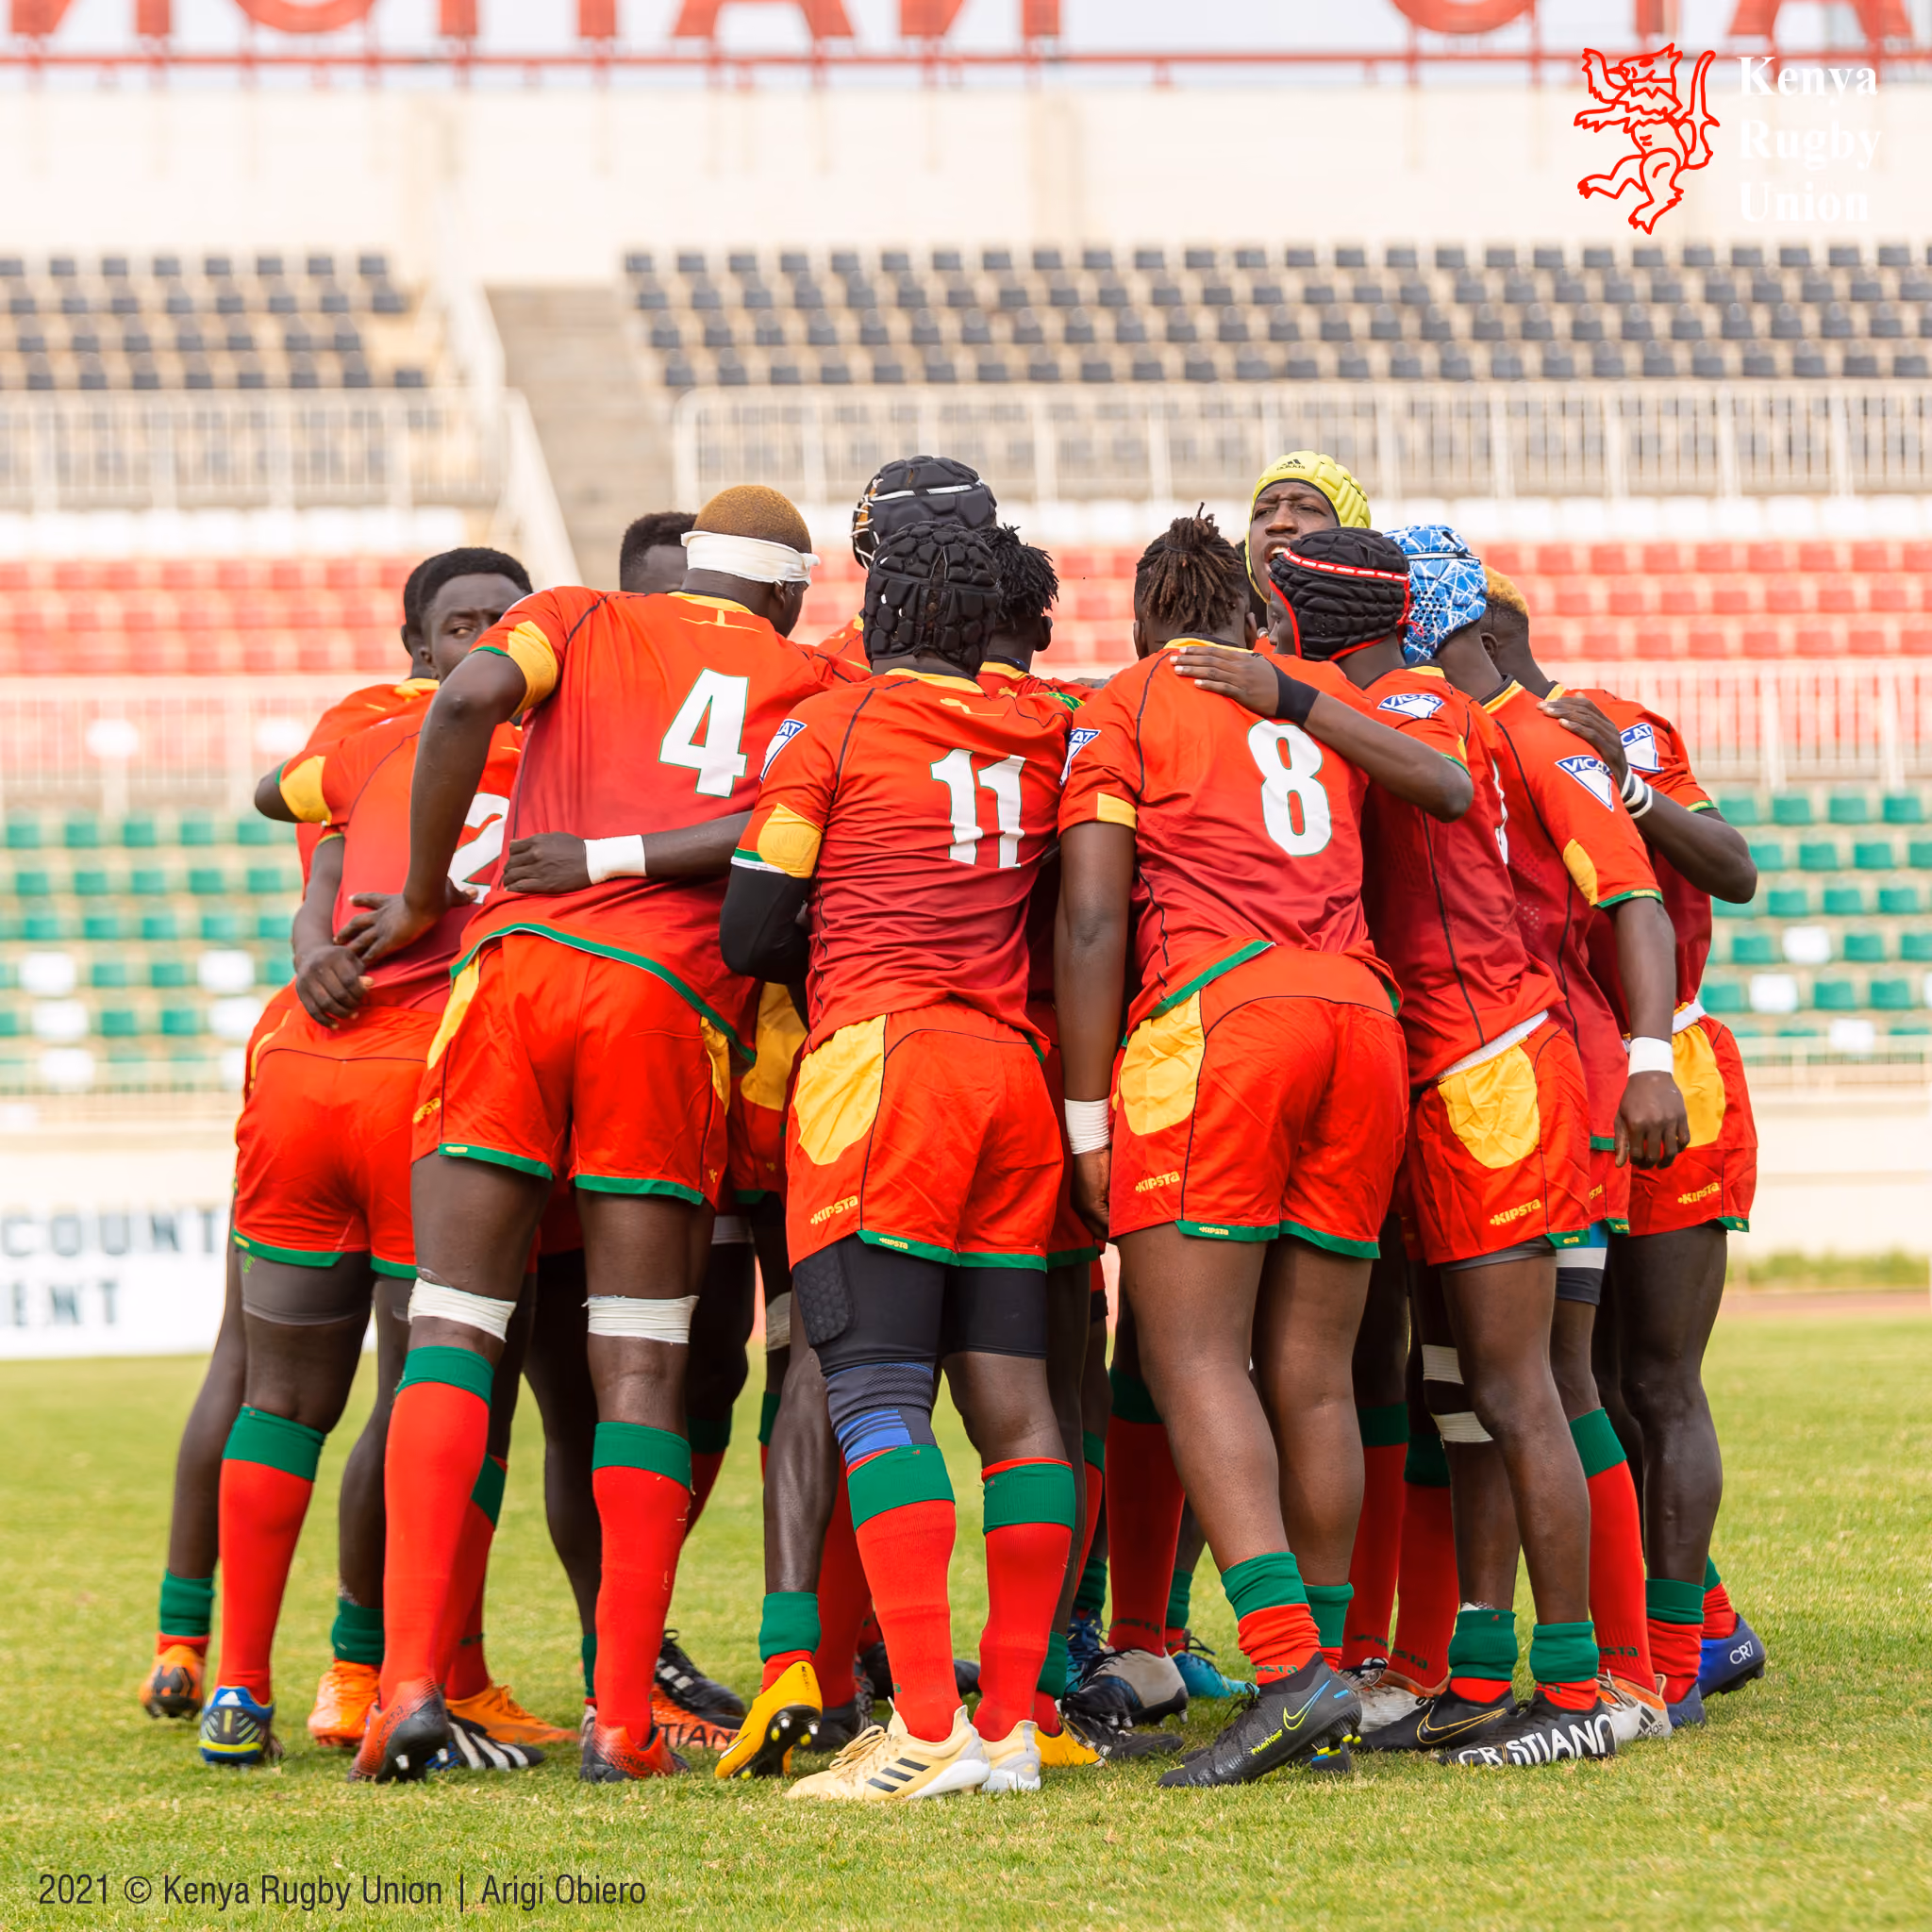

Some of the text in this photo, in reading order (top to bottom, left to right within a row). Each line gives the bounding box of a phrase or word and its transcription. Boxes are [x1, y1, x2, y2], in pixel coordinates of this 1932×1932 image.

[660, 668, 748, 797] 4
[1621, 724, 1652, 746] CAT
[930, 749, 1025, 869] 11
[1248, 719, 1332, 857] 8
[447, 792, 510, 904] 2
[2, 1210, 219, 1257] COUNT
[1729, 1641, 1754, 1665] CR7
[659, 1722, 740, 1748] TIAN
